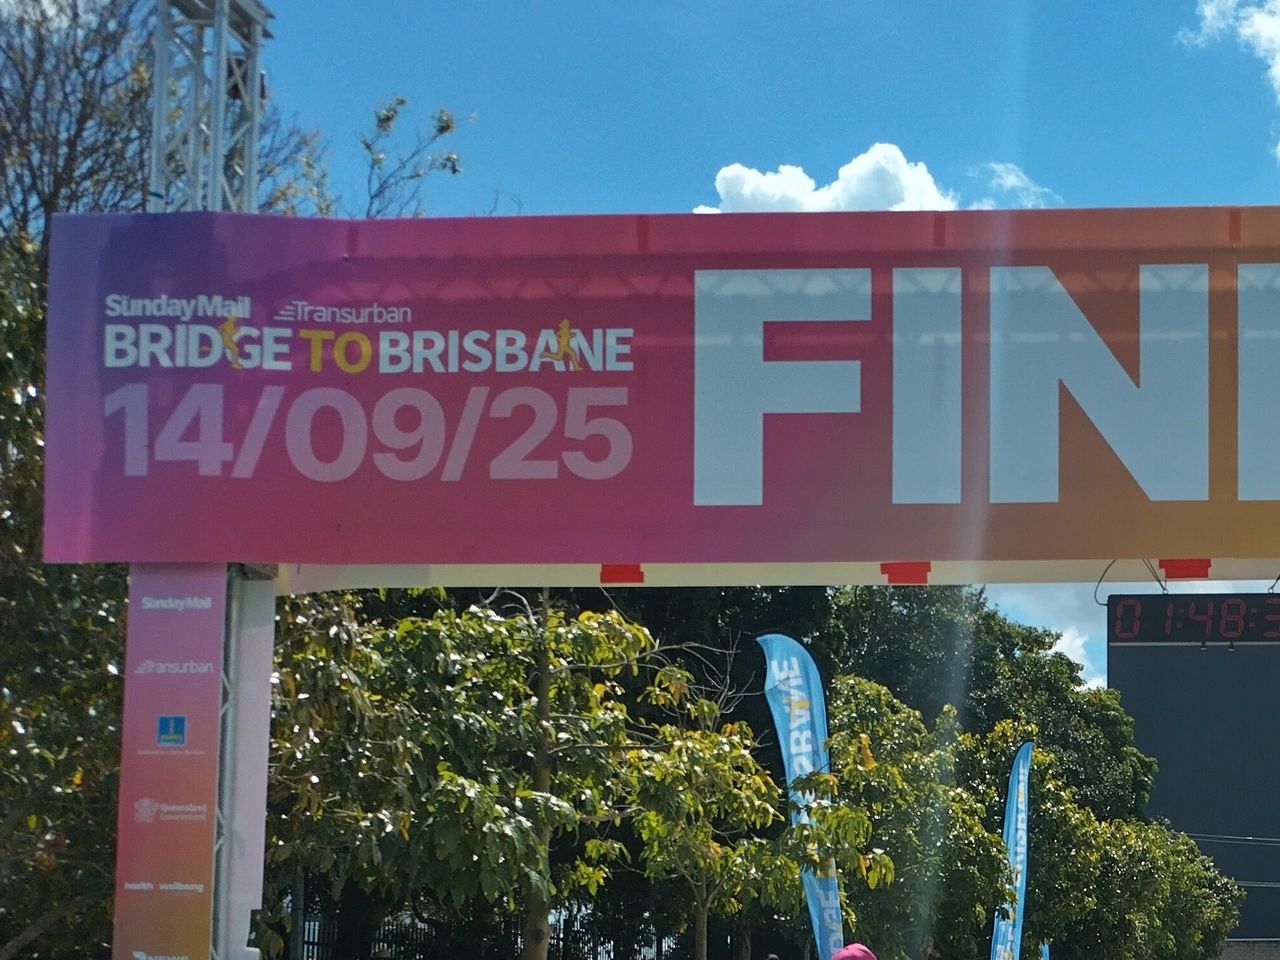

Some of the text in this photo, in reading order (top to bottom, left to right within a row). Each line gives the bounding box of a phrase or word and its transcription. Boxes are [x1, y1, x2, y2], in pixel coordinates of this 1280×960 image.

[292, 300, 412, 324] Transurban
[104, 322, 635, 374] BRIDGE TO BRISBANE
[103, 381, 634, 483] 14/09/25
